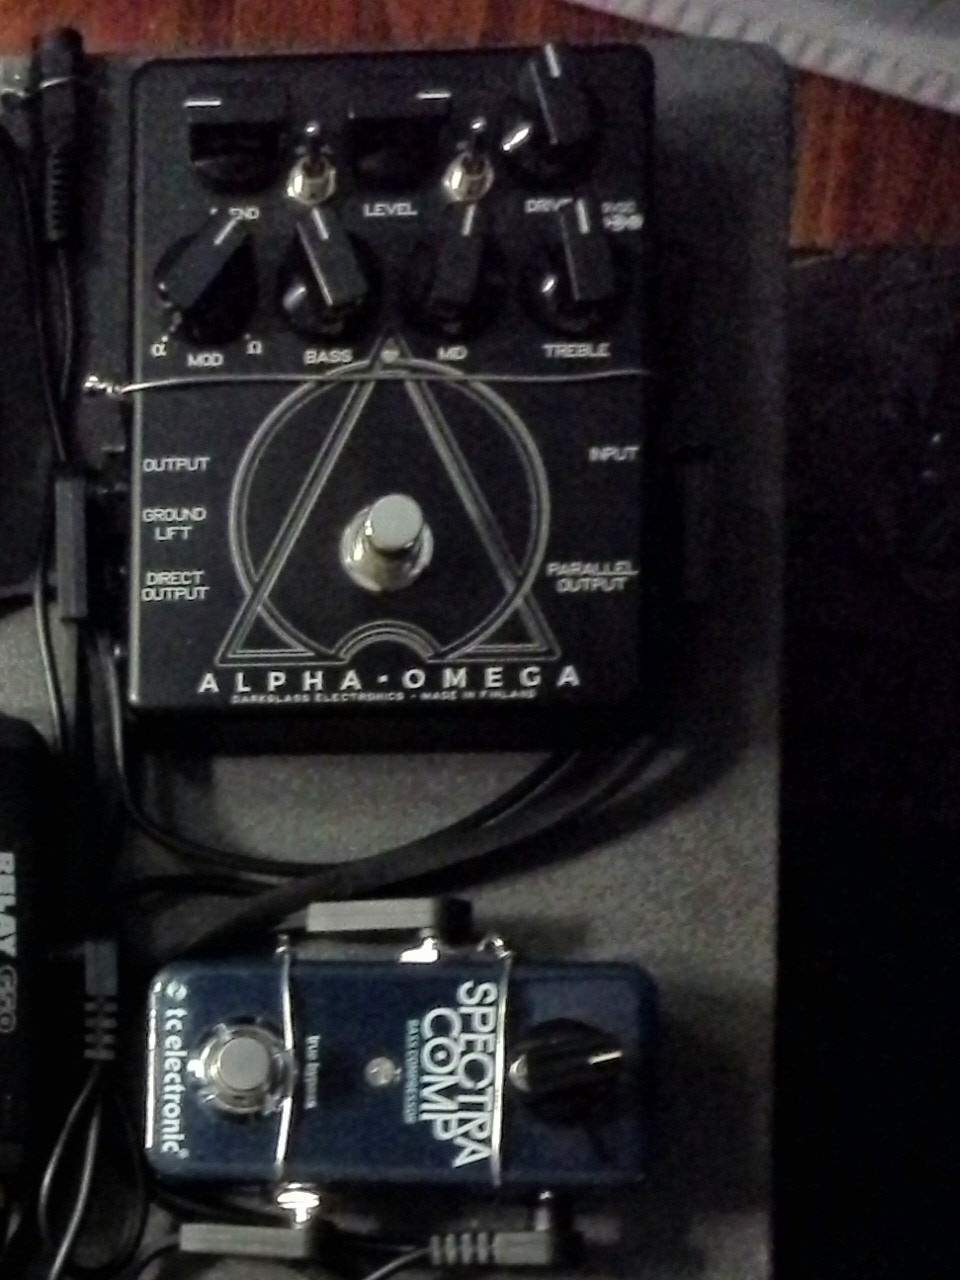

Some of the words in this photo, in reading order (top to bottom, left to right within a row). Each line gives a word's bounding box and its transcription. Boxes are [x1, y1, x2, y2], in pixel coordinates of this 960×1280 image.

[363, 203, 418, 217] LEVEL
[304, 349, 353, 365] BASS
[542, 343, 611, 359] TREBLE
[187, 353, 224, 368] MOD
[588, 447, 639, 462] INPUT
[143, 458, 210, 472] OUTPUT
[142, 507, 207, 522] GROUND
[155, 526, 190, 541] LIFT
[546, 561, 639, 577] PARALLEL
[146, 571, 203, 586] DIRECT
[557, 577, 628, 593] OUTPUT
[142, 587, 209, 602] OUTPUT
[306, 1035, 321, 1060] true
[419, 1007, 463, 1141] COMP
[451, 980, 499, 1169] SPECTRA
[161, 1035, 189, 1152] electronic
